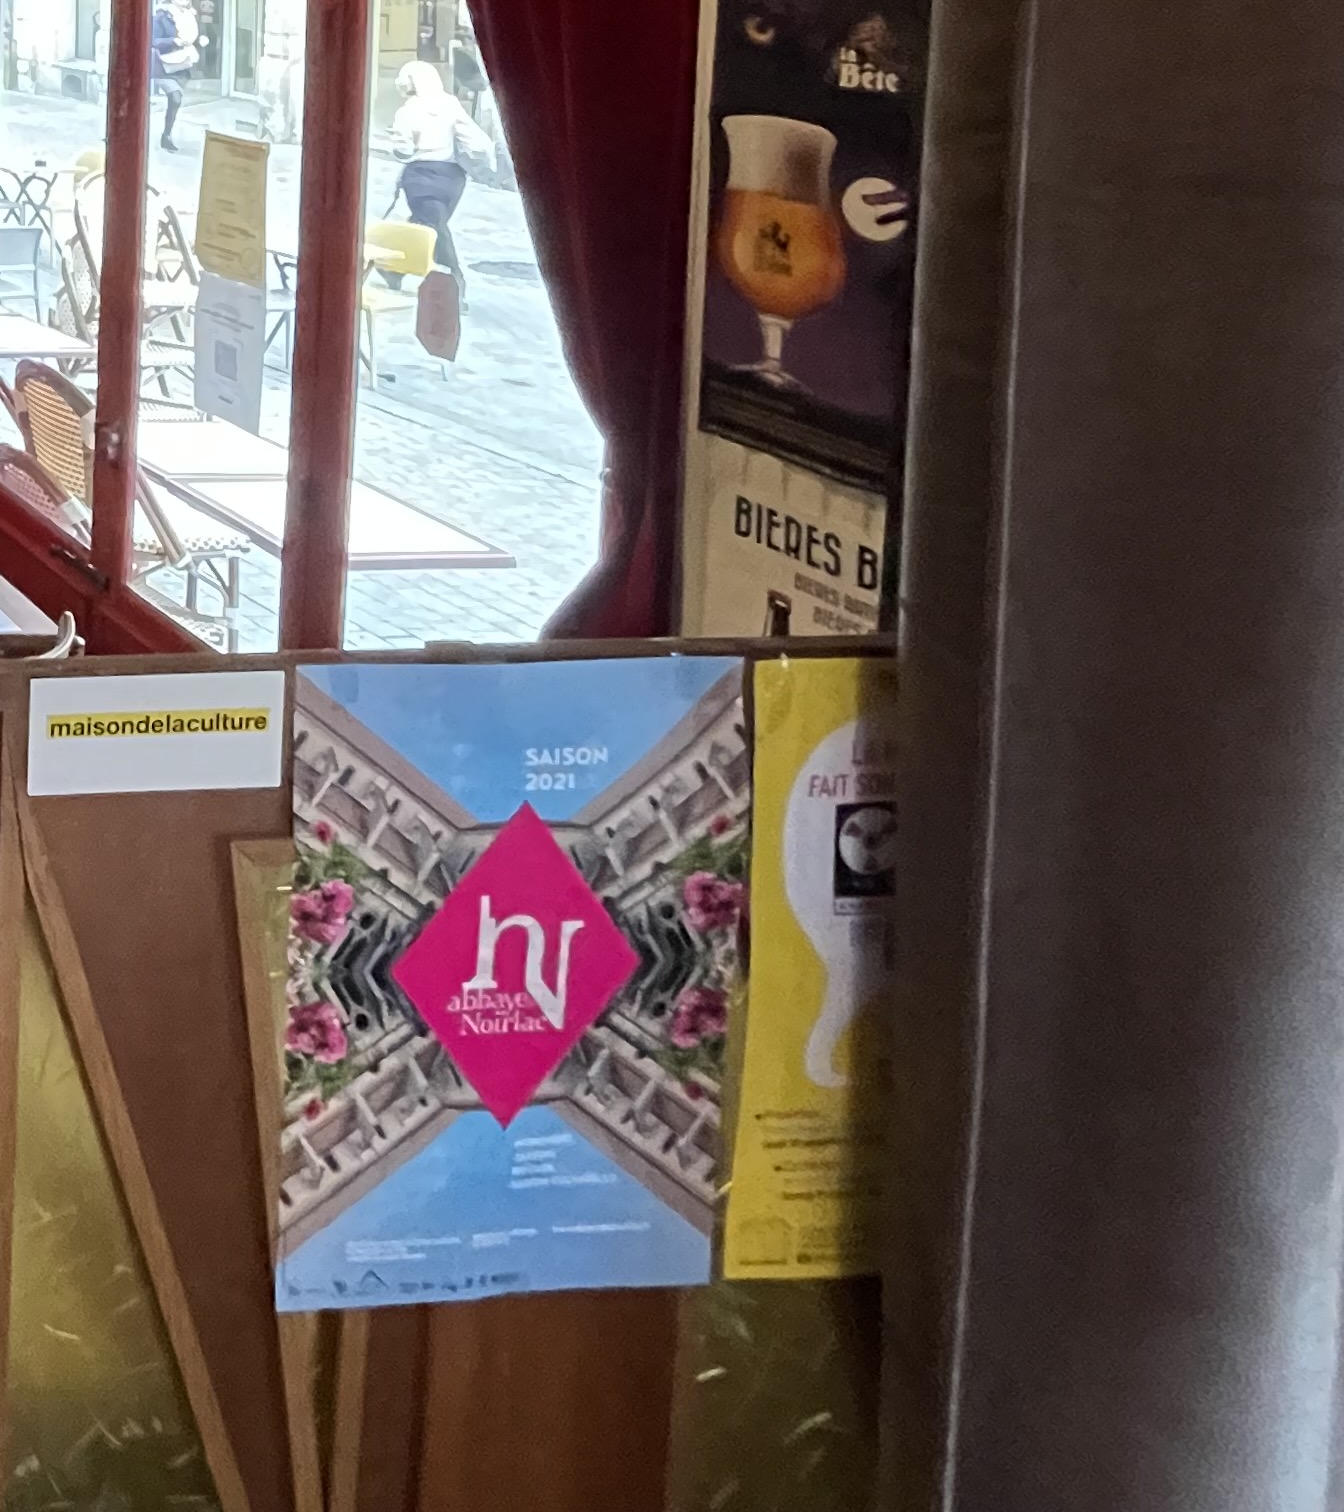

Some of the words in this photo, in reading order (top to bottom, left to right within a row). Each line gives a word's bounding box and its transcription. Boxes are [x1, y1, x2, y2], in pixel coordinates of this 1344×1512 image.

[839, 63, 900, 93] Bête
[734, 494, 842, 577] BIERES
[50, 713, 268, 737] maisondelaculture
[525, 747, 608, 766] SAISON
[525, 773, 576, 791] 2021
[808, 773, 849, 798] FAIT
[460, 1009, 548, 1036] Noirlac
